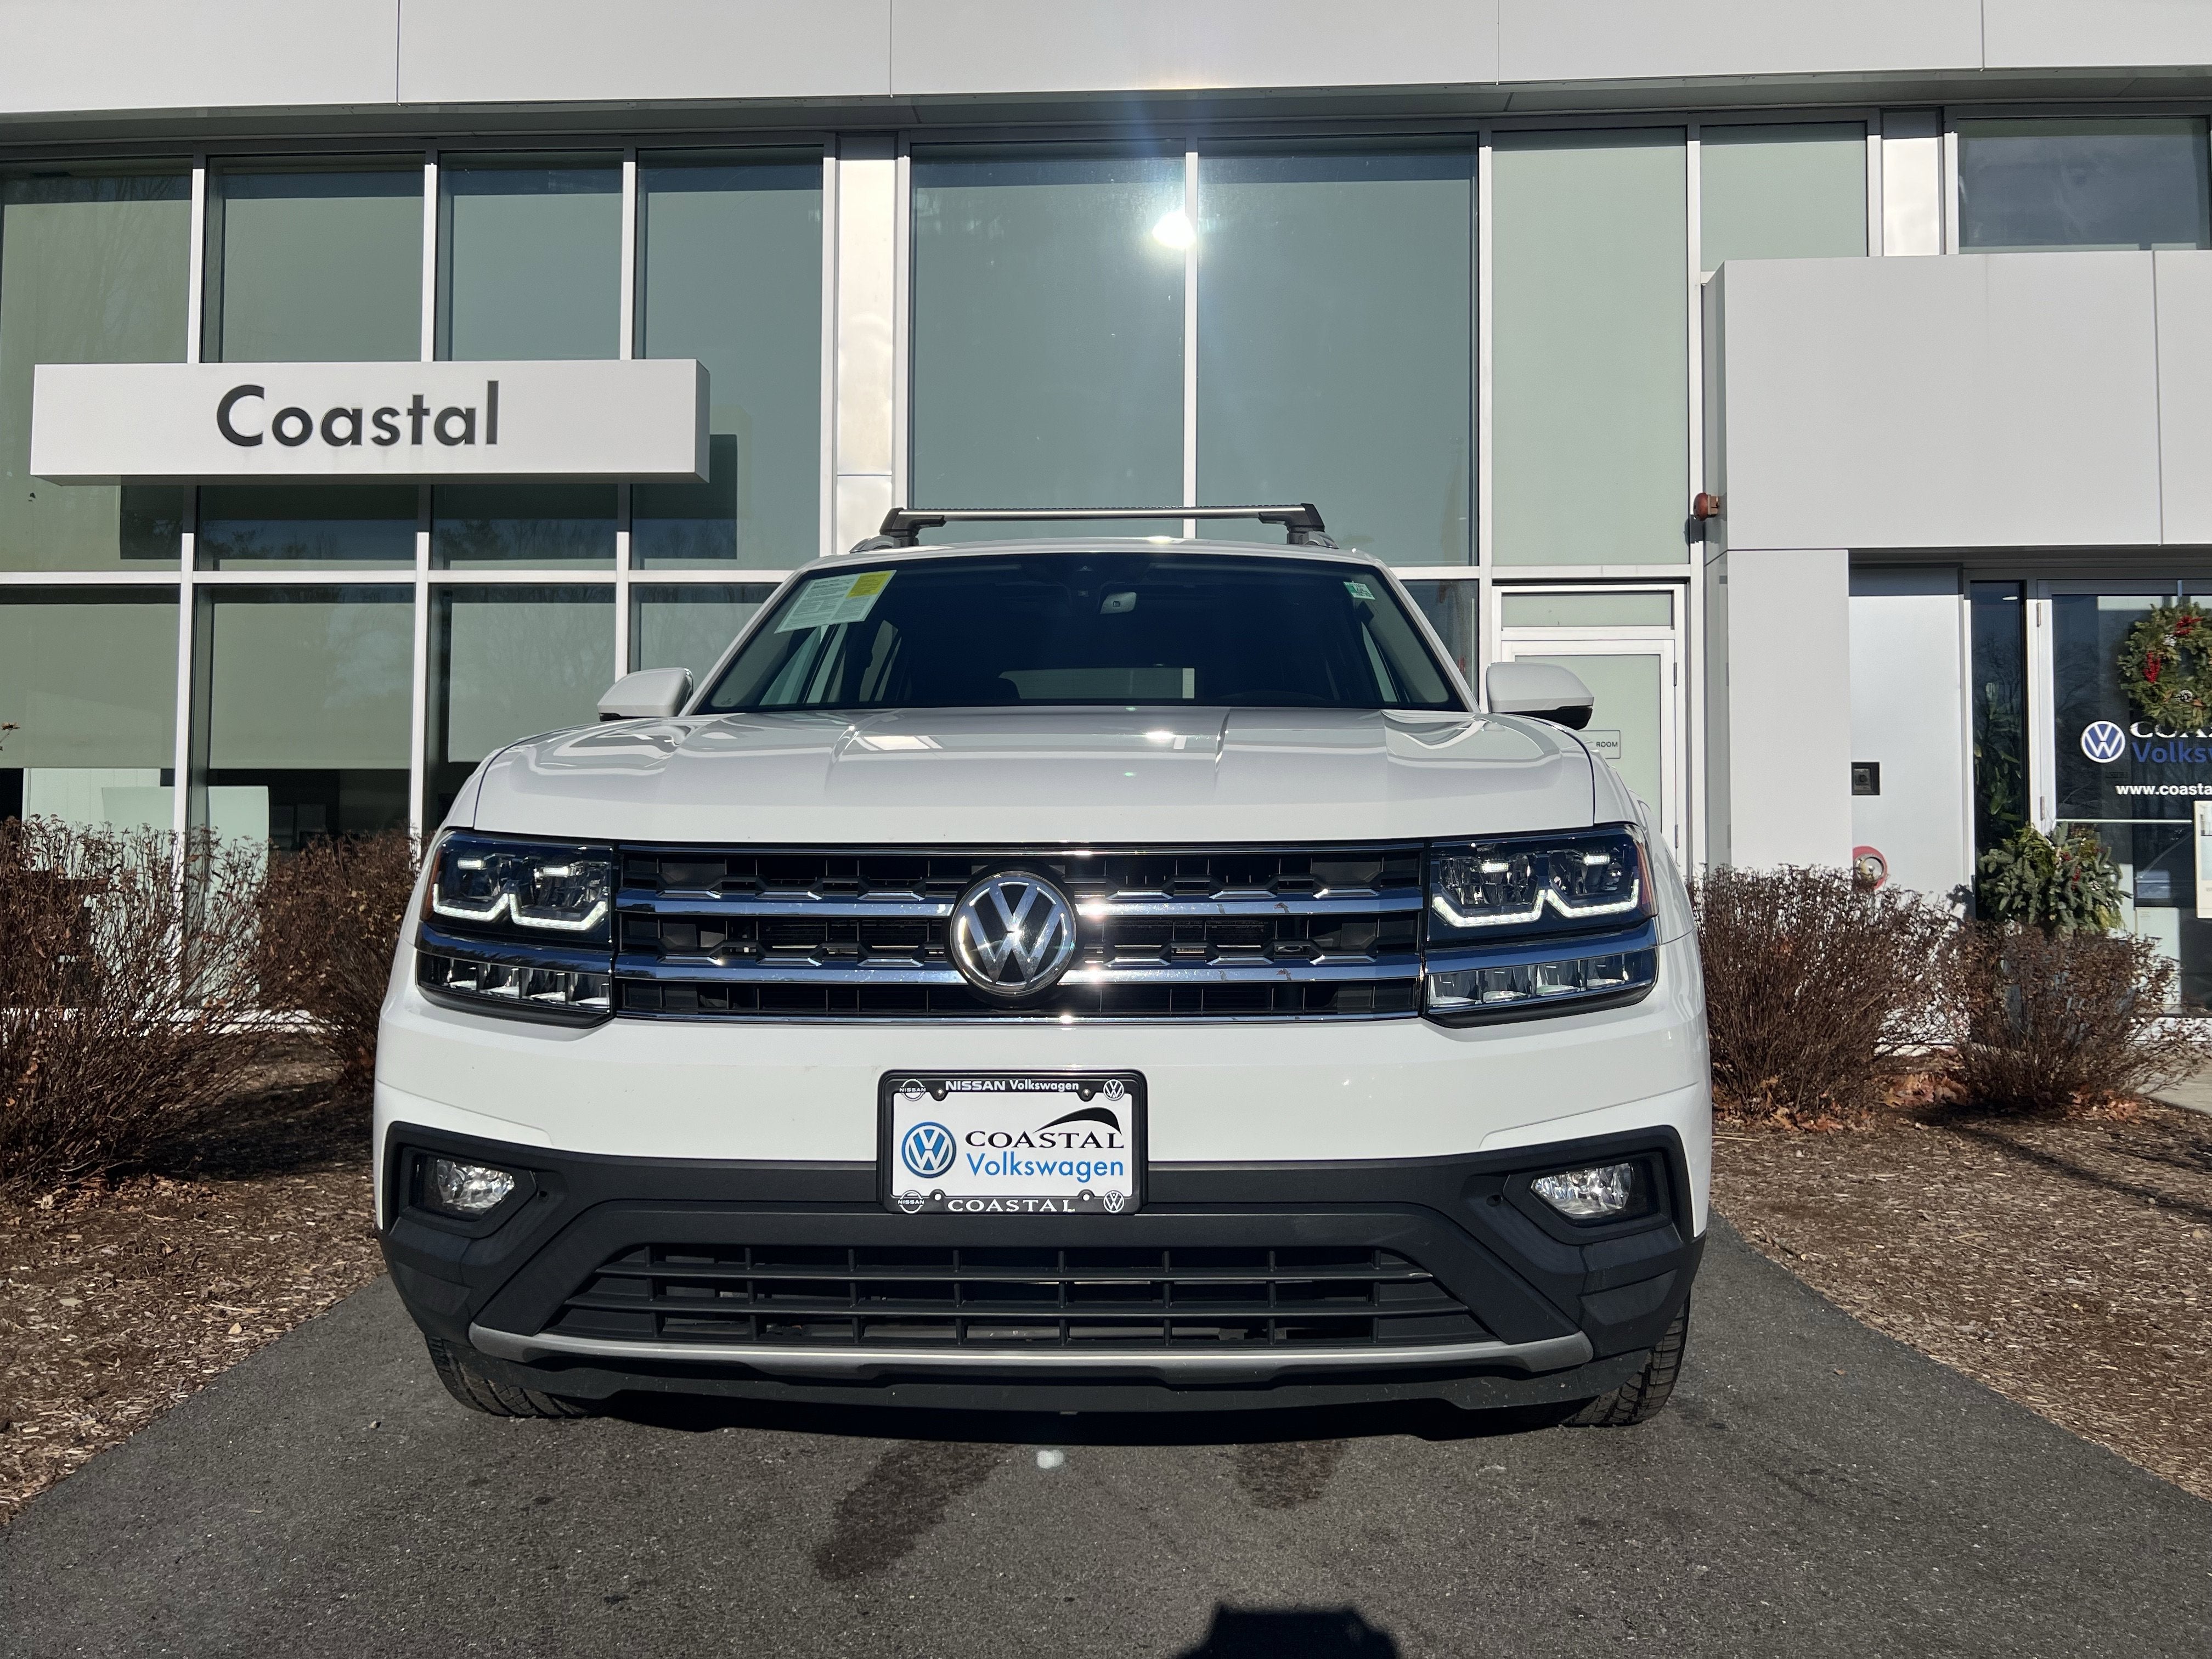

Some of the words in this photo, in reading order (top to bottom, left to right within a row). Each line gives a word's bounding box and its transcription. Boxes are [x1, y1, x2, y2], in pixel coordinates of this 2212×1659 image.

[216, 380, 499, 447] Coastal
[2080, 720, 2126, 763] VW
[952, 873, 1074, 994] VW
[945, 1080, 1006, 1091] NISSAN
[1009, 1079, 1079, 1093] Volkswagen
[1103, 1079, 1124, 1101] VW
[901, 1121, 956, 1178] VW
[965, 1131, 1124, 1149] COASTAL
[966, 1151, 1124, 1183] Volkswagen
[947, 1199, 1075, 1212] COASTAL
[1103, 1190, 1125, 1213] VW
